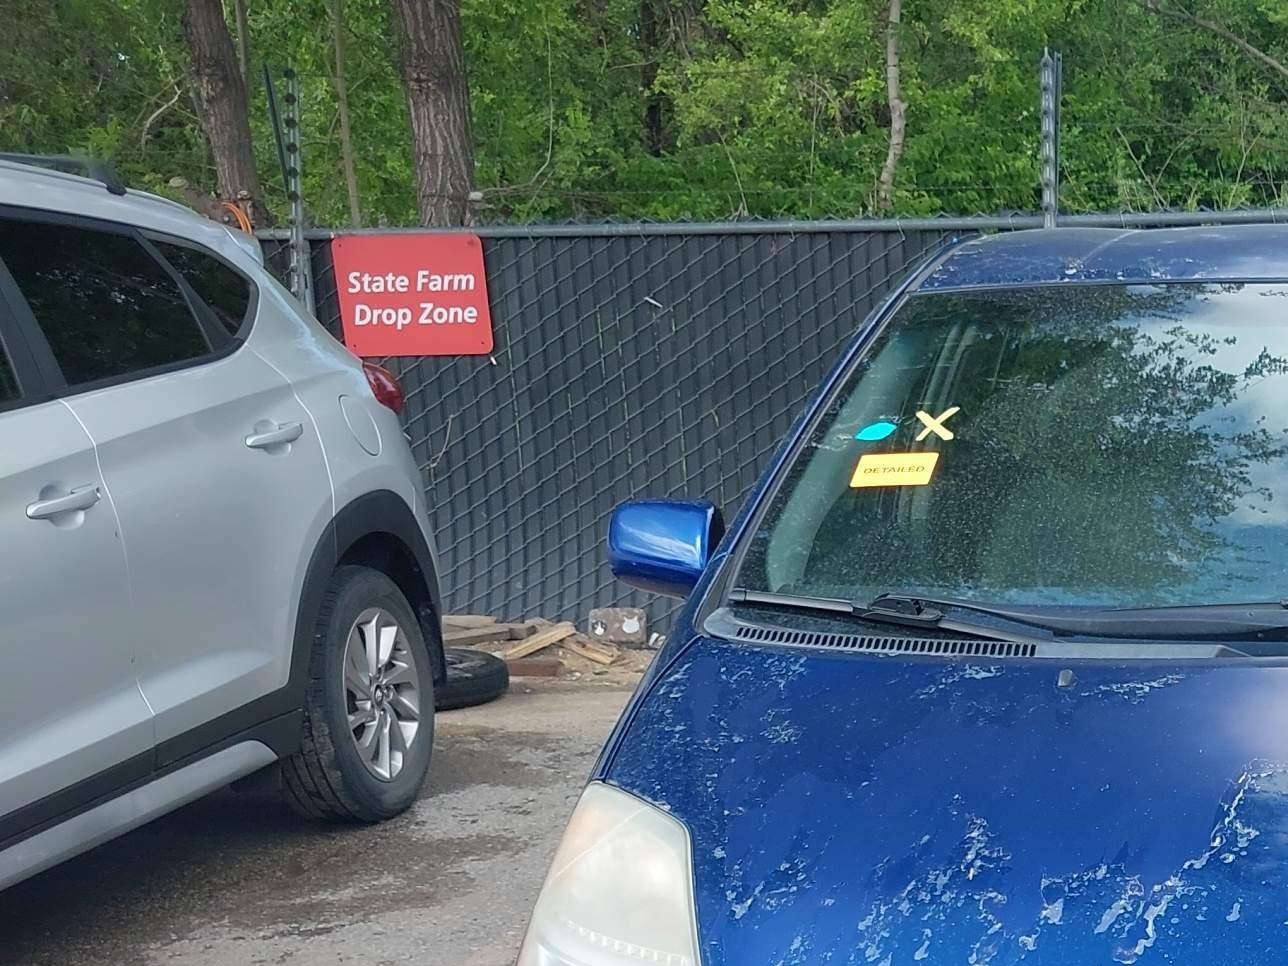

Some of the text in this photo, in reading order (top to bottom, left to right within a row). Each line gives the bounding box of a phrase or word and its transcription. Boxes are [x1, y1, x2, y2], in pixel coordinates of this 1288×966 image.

[348, 270, 475, 293] State Farm
[354, 303, 478, 330] Drop Zone
[863, 466, 925, 474] DETAILED
